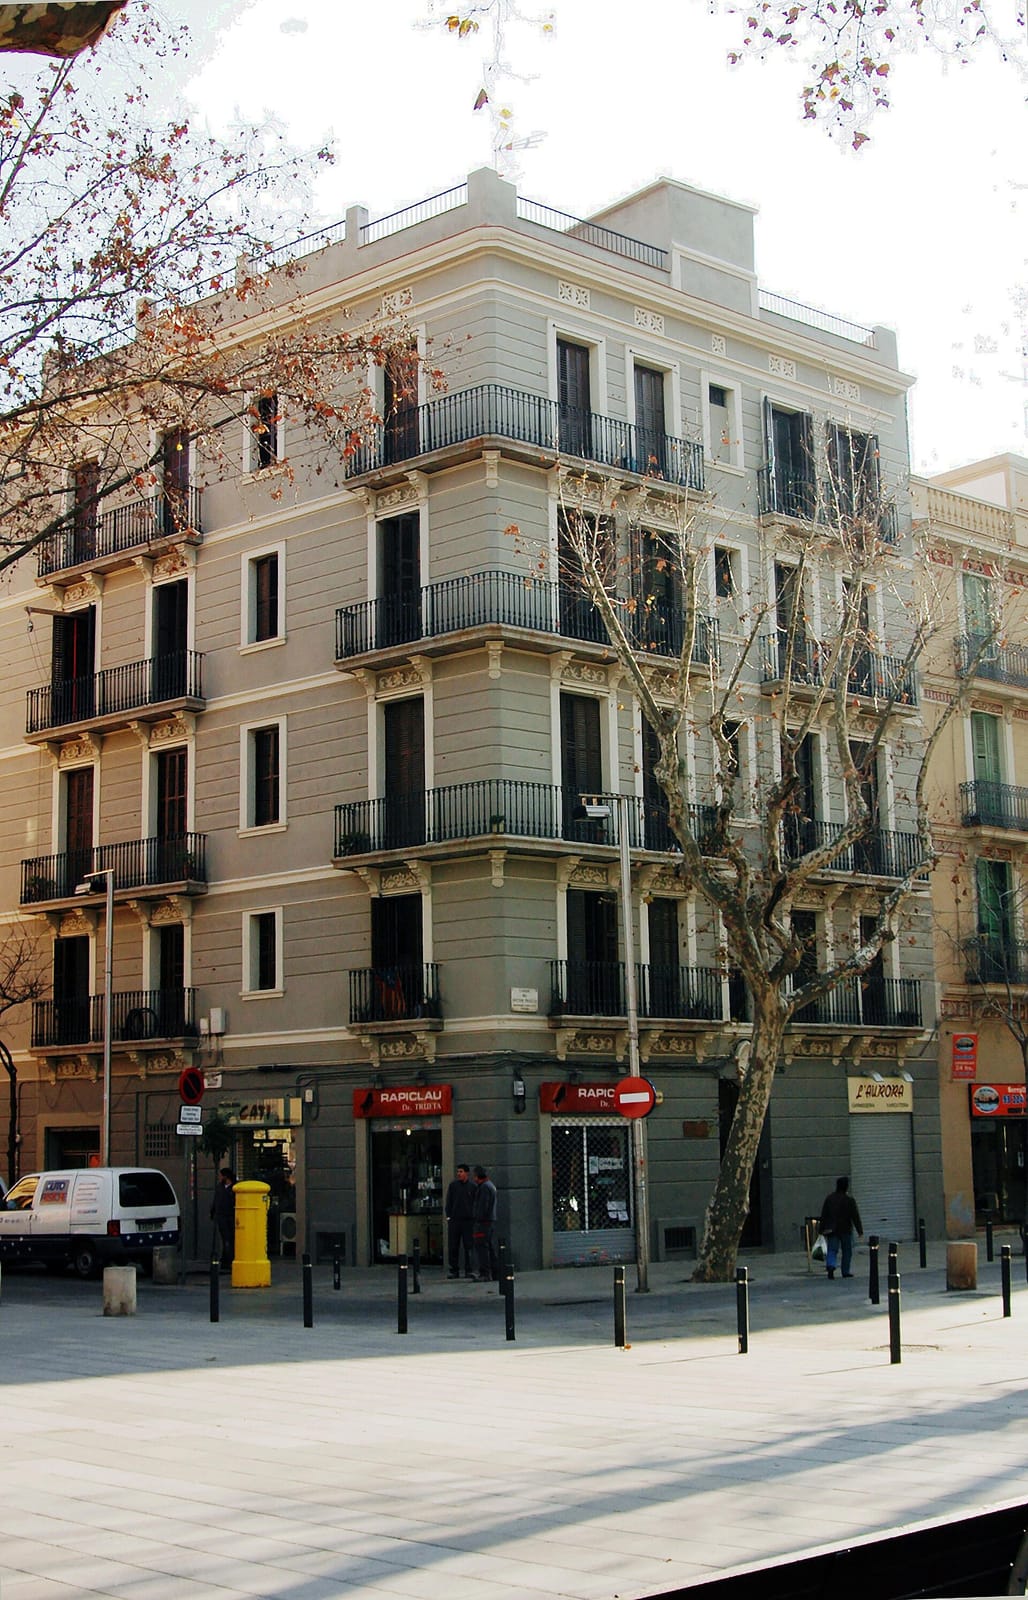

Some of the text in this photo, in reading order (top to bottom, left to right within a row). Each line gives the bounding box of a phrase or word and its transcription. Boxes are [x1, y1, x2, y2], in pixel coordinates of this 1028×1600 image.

[380, 1090, 442, 1103] RAPICLAU
[578, 1088, 615, 1098] RAPIC
[856, 1084, 905, 1099] L'AURORA
